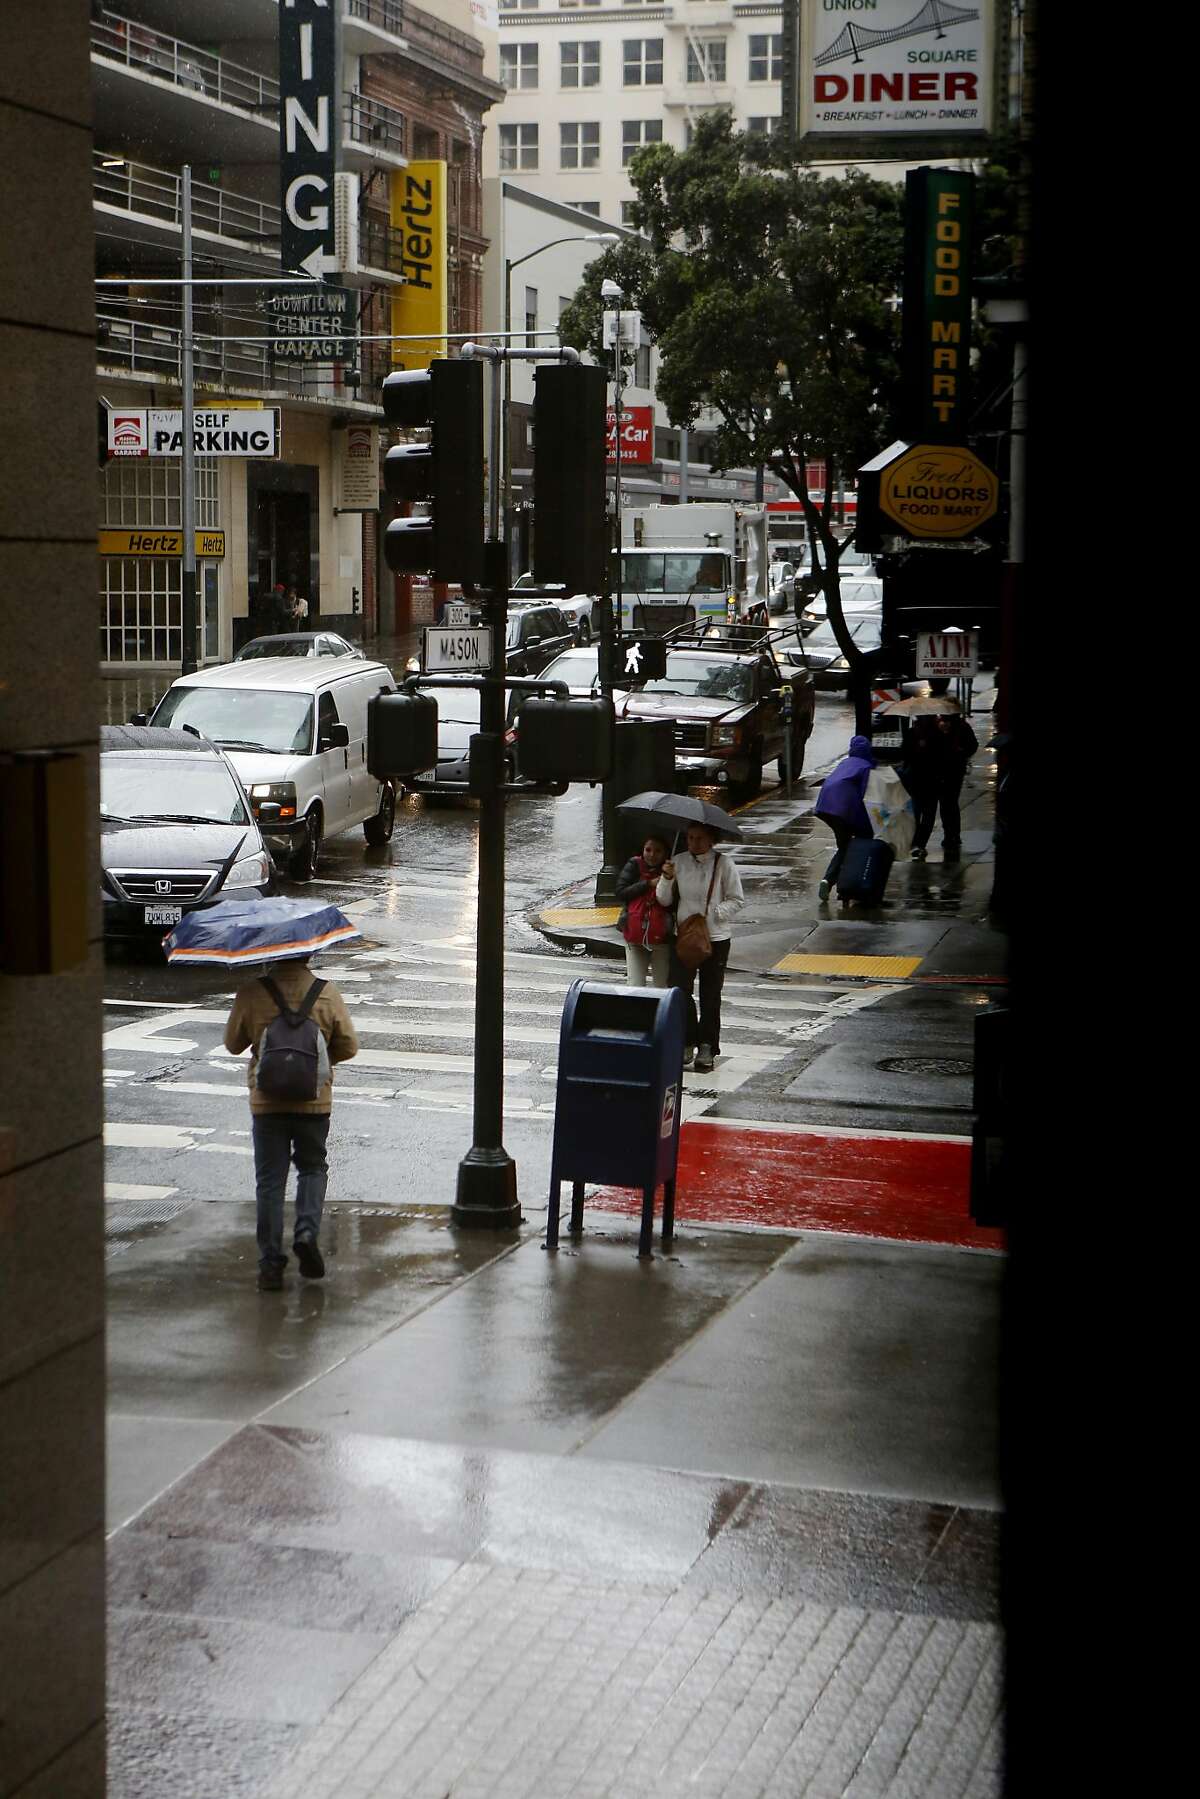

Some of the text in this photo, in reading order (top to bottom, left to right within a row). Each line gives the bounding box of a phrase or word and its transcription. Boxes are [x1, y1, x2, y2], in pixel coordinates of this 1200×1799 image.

[823, 0, 877, 11] UNION
[907, 50, 977, 63] SQUARE
[814, 72, 978, 104] DINER
[285, 0, 329, 231] ING
[823, 109, 978, 121] BREAKFAST LUNCH DINNER
[400, 175, 432, 290] Hertz
[272, 294, 346, 312] DOWNTOWN
[931, 192, 961, 423] FOOD MART
[277, 315, 342, 334] CENTER
[274, 339, 344, 356] GARAGE
[194, 414, 229, 428] SELF
[155, 430, 270, 451] PARKING
[911, 461, 974, 484] Fred's
[893, 485, 989, 501] LIQUORS
[900, 503, 981, 516] FOOD MART
[129, 534, 178, 551] Hertz
[203, 535, 222, 553] Hertz
[440, 637, 479, 660] MASON
[924, 635, 969, 658] ATM
